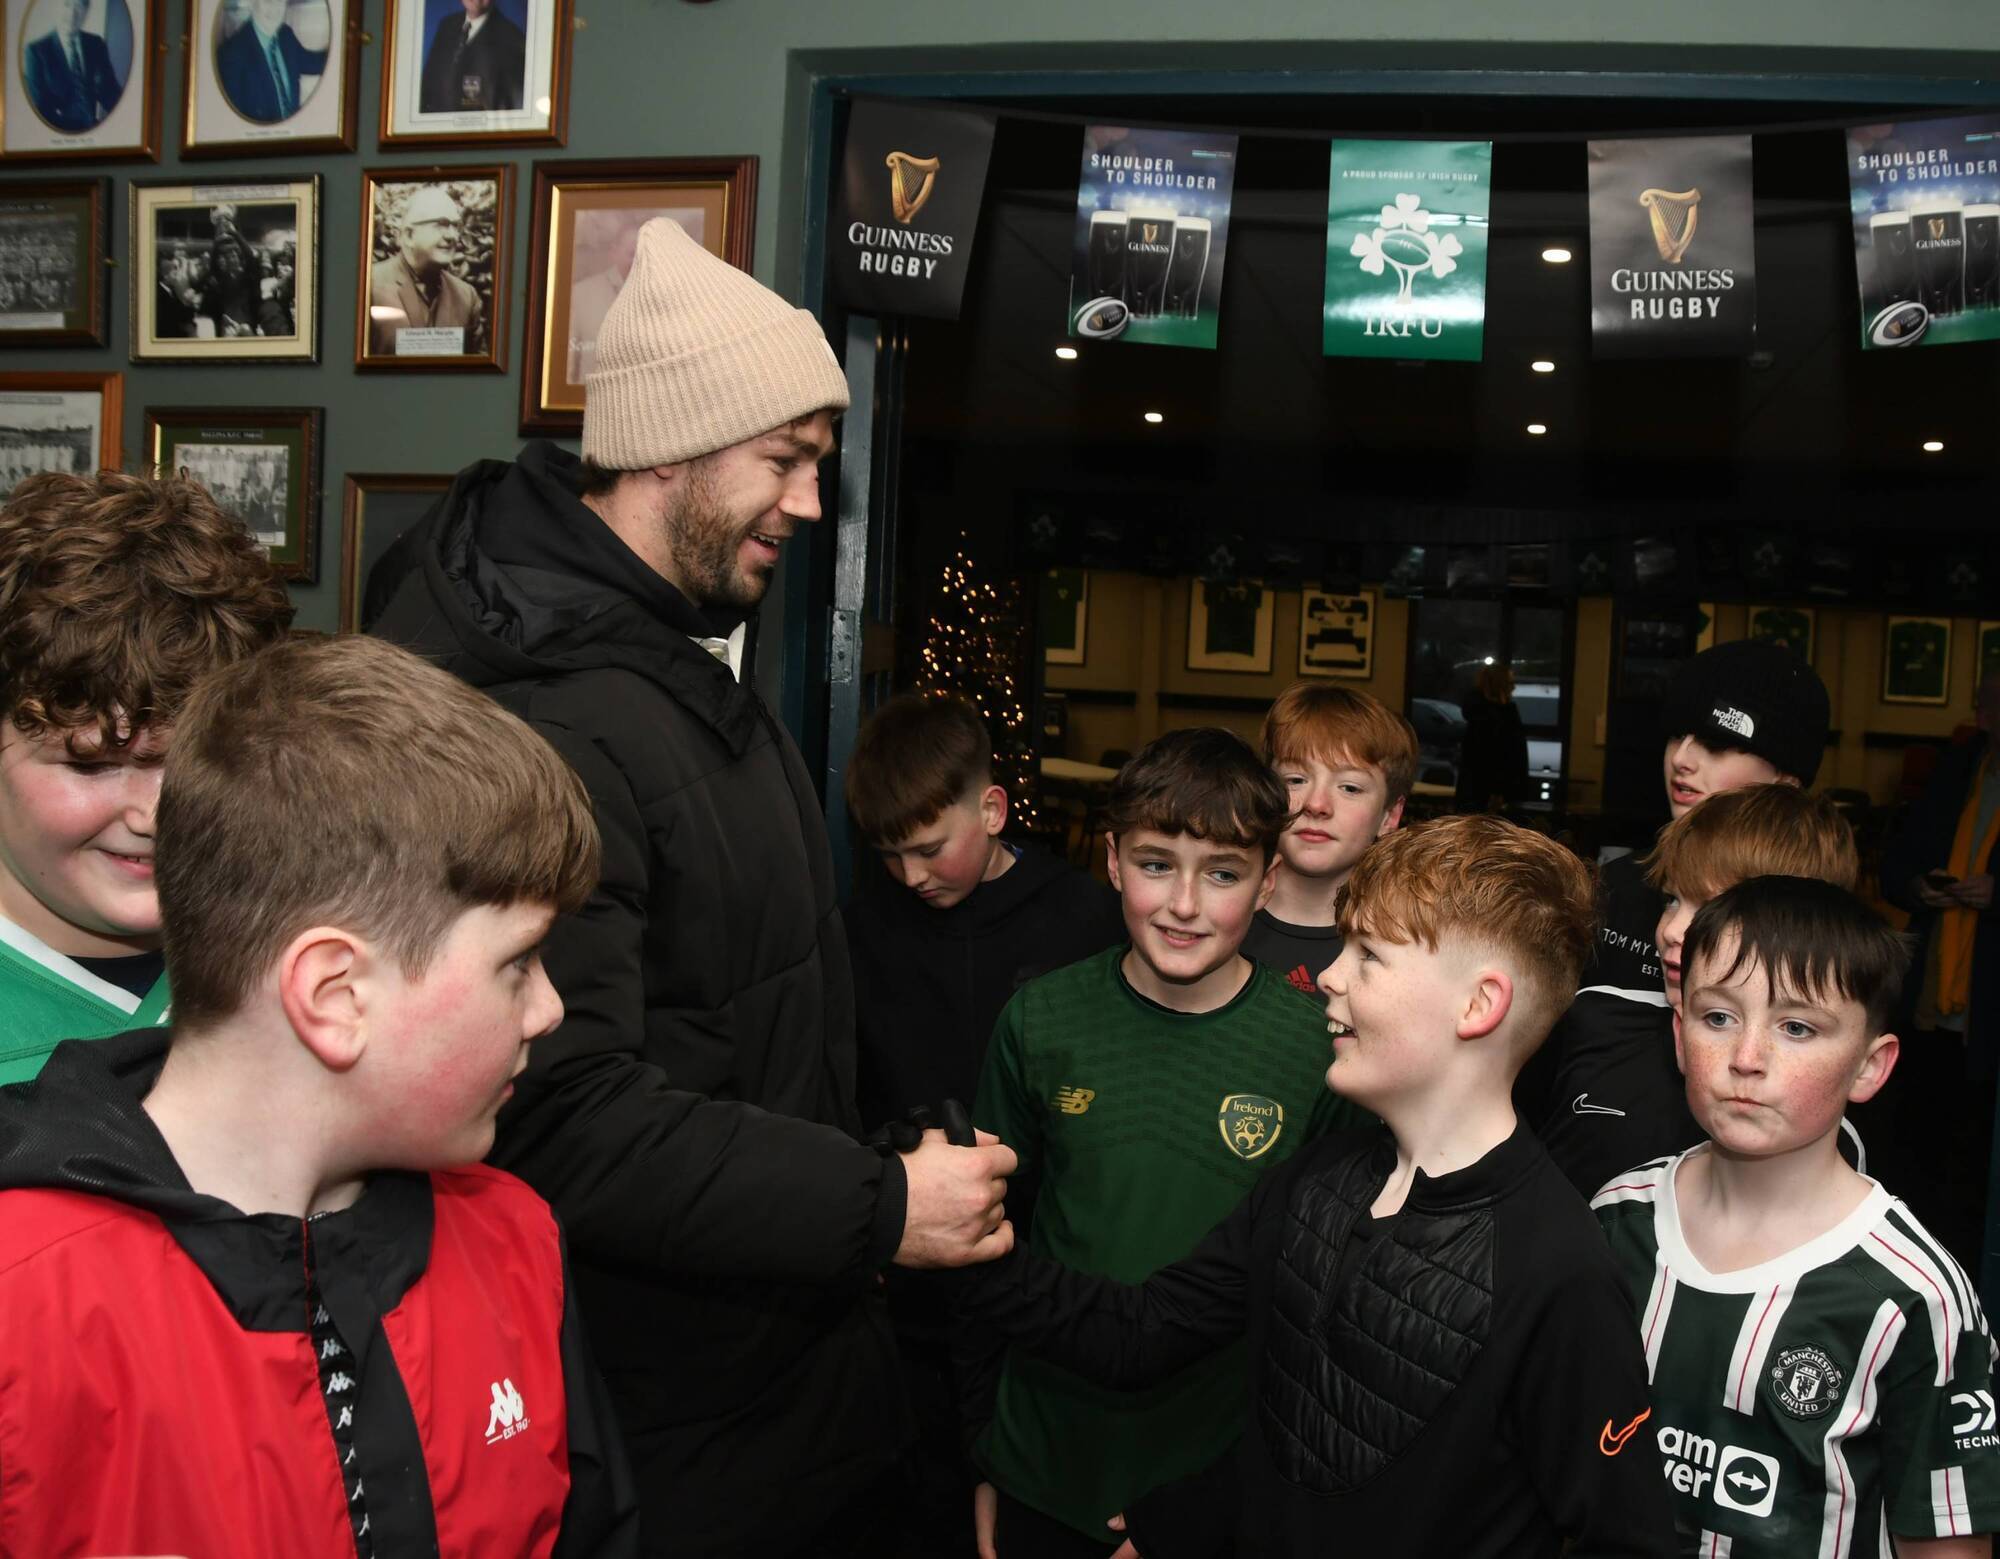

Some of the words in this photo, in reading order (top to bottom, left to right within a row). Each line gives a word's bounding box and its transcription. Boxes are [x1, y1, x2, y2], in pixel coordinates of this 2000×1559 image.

[1091, 154, 1173, 172] SHOULDER
[1858, 149, 1948, 169] SHOULDER
[1106, 170, 1125, 184] TO
[1133, 172, 1216, 190] SHOULDER
[1877, 168, 1898, 183] TO
[1907, 160, 1998, 181] SHOULDER
[848, 221, 953, 254] GUINNESS
[1128, 241, 1170, 253] GUINNESS
[1916, 239, 1961, 249] GUINNESS
[860, 251, 937, 279] RUGBY
[1611, 268, 1734, 292] GUINNESS
[1631, 297, 1720, 319] RUGBY
[1713, 709, 1742, 725] NORTH
[1729, 707, 1744, 720] THE
[1718, 718, 1740, 731] FACE
[1233, 1100, 1273, 1116] Ireland
[1783, 1352, 1836, 1383] MANCHESTER
[1780, 1392, 1818, 1412] UNITED
[1657, 1426, 1716, 1469] am
